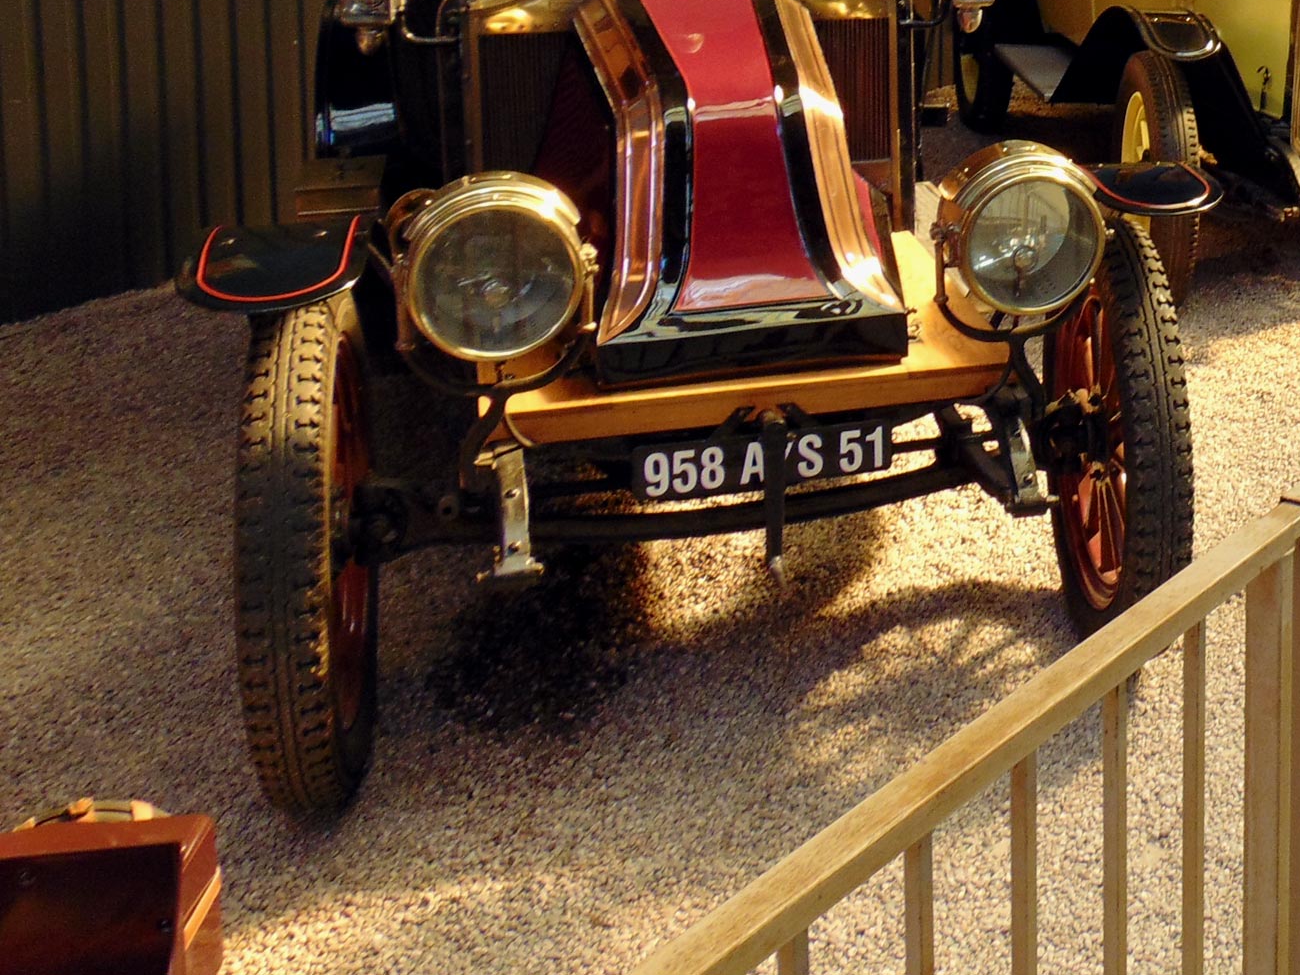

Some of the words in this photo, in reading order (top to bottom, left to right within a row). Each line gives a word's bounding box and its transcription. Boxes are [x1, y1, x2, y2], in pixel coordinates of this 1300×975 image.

[644, 446, 725, 497] 958
[740, 434, 824, 486] AS
[839, 425, 884, 474] 51
